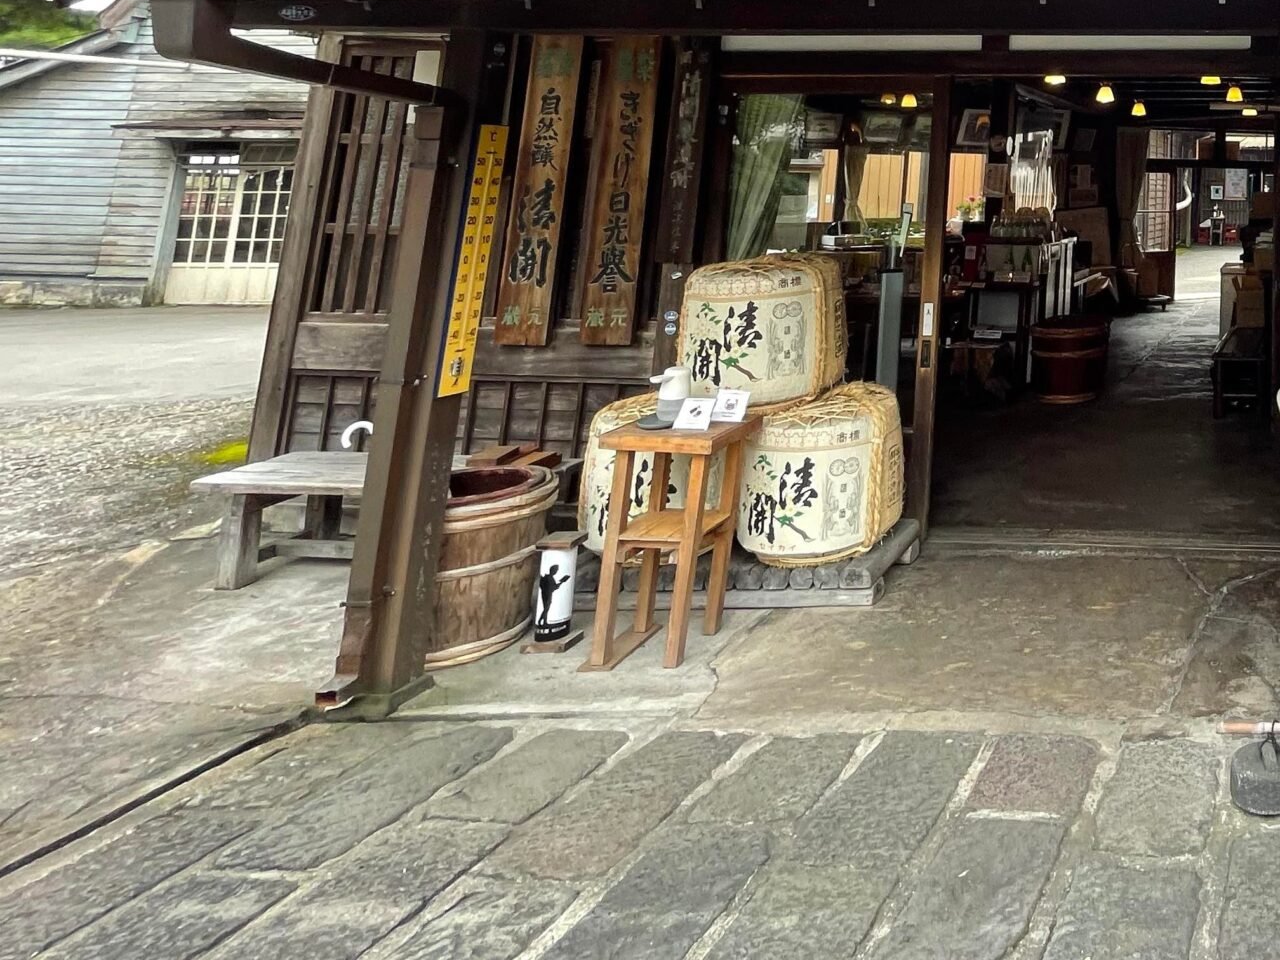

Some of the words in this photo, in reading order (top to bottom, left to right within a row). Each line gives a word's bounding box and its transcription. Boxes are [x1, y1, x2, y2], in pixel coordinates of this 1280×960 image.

[477, 158, 486, 166] 50
[493, 158, 502, 166] 50
[474, 177, 483, 185] 40
[491, 177, 500, 185] 40
[470, 196, 480, 205] 30
[488, 196, 497, 205] 30
[467, 216, 477, 225] 20
[484, 215, 494, 224] 20
[465, 235, 474, 244] 10
[482, 235, 491, 244] 10
[778, 276, 802, 289] 商標
[836, 429, 860, 444] 商標
